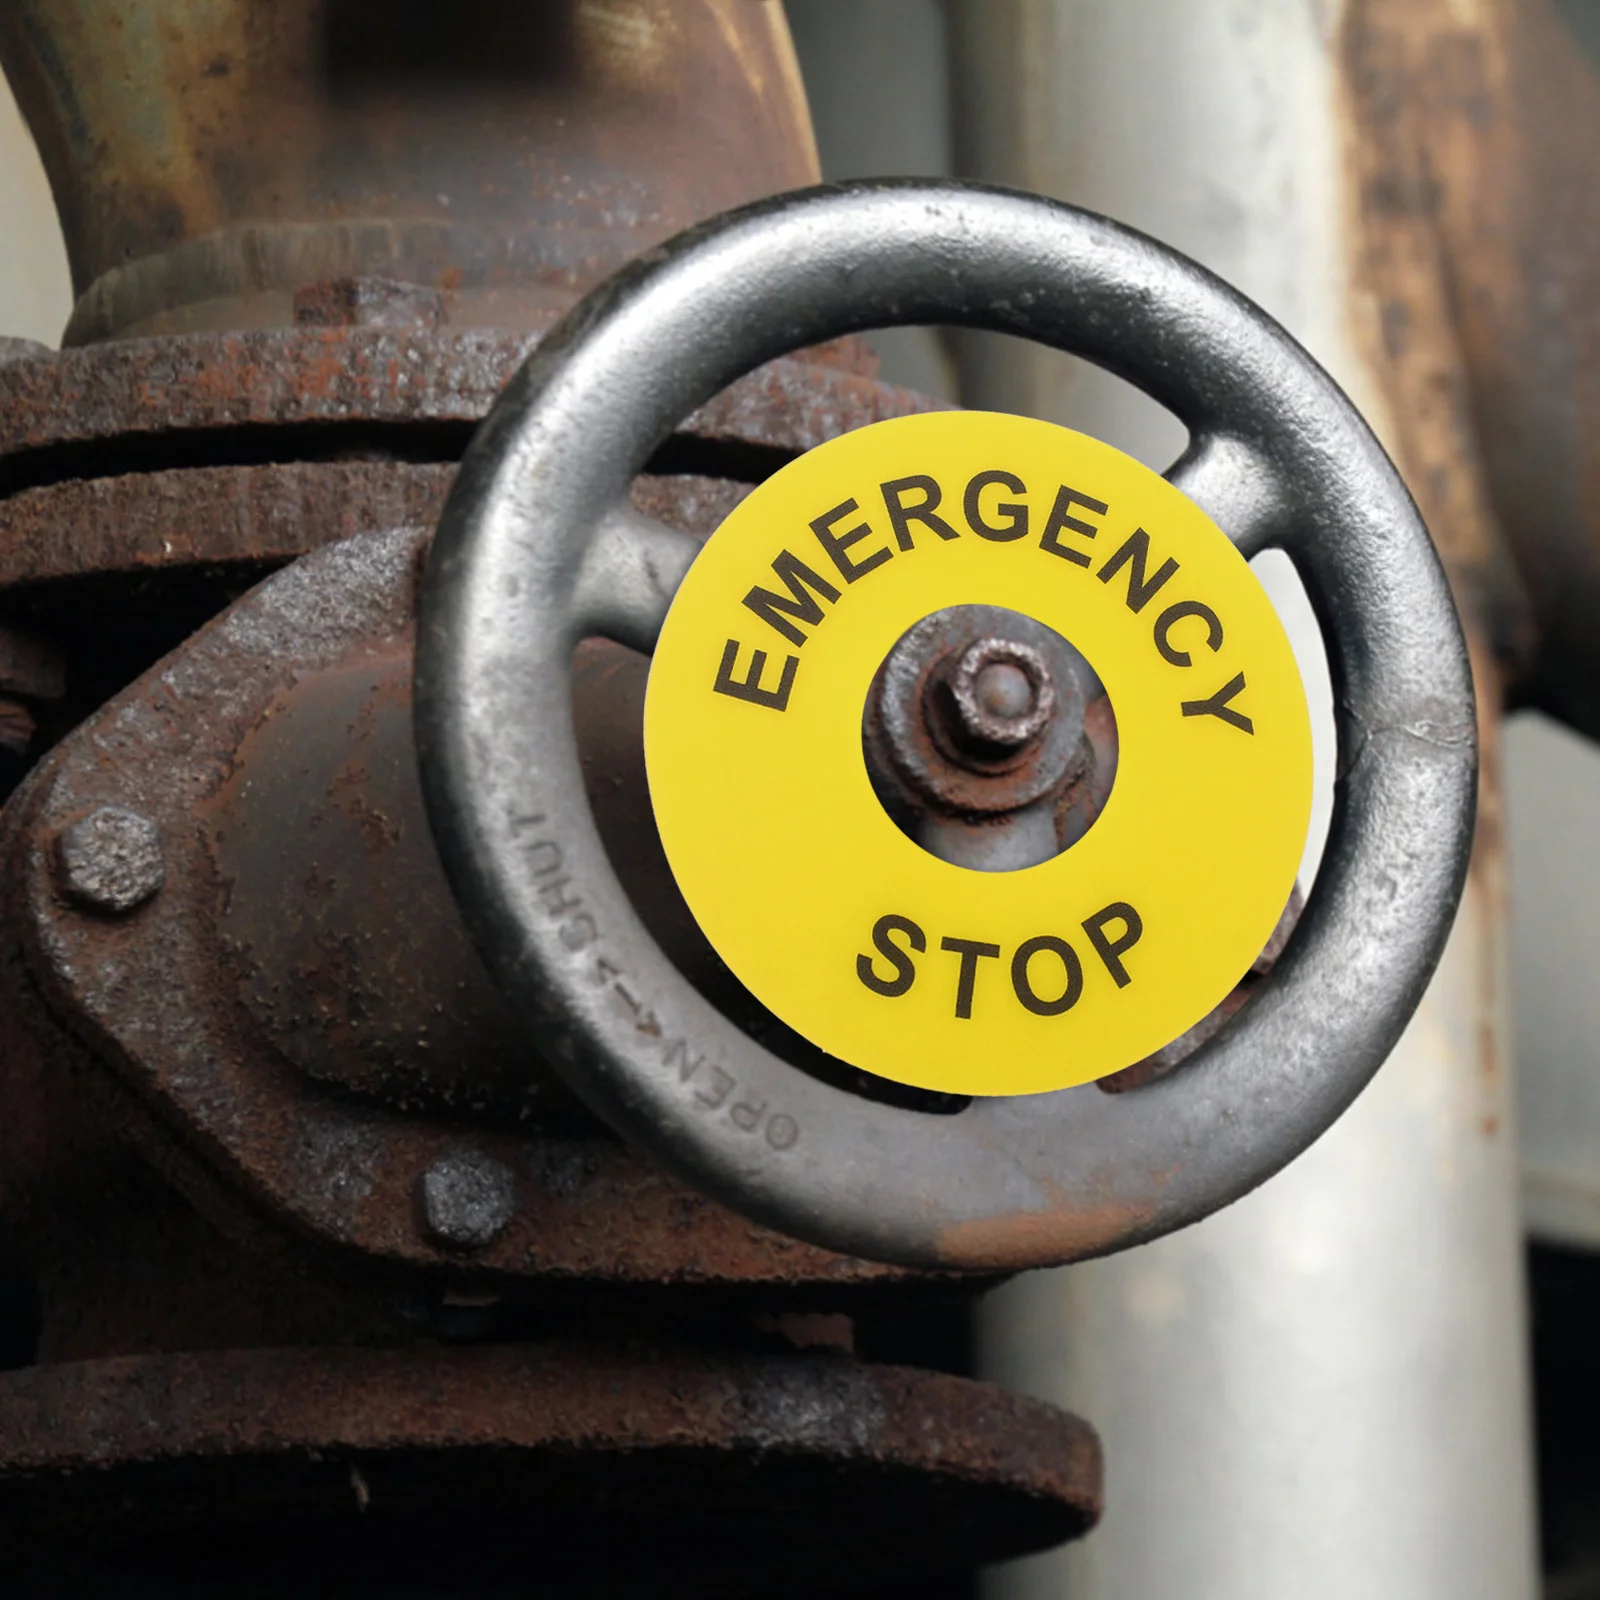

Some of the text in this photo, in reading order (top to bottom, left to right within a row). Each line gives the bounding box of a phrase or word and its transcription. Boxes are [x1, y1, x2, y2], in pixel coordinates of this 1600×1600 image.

[713, 470, 1254, 736] EMERGENCY
[505, 804, 799, 1151] OPEN SHUT
[857, 902, 1143, 1020] STOP
